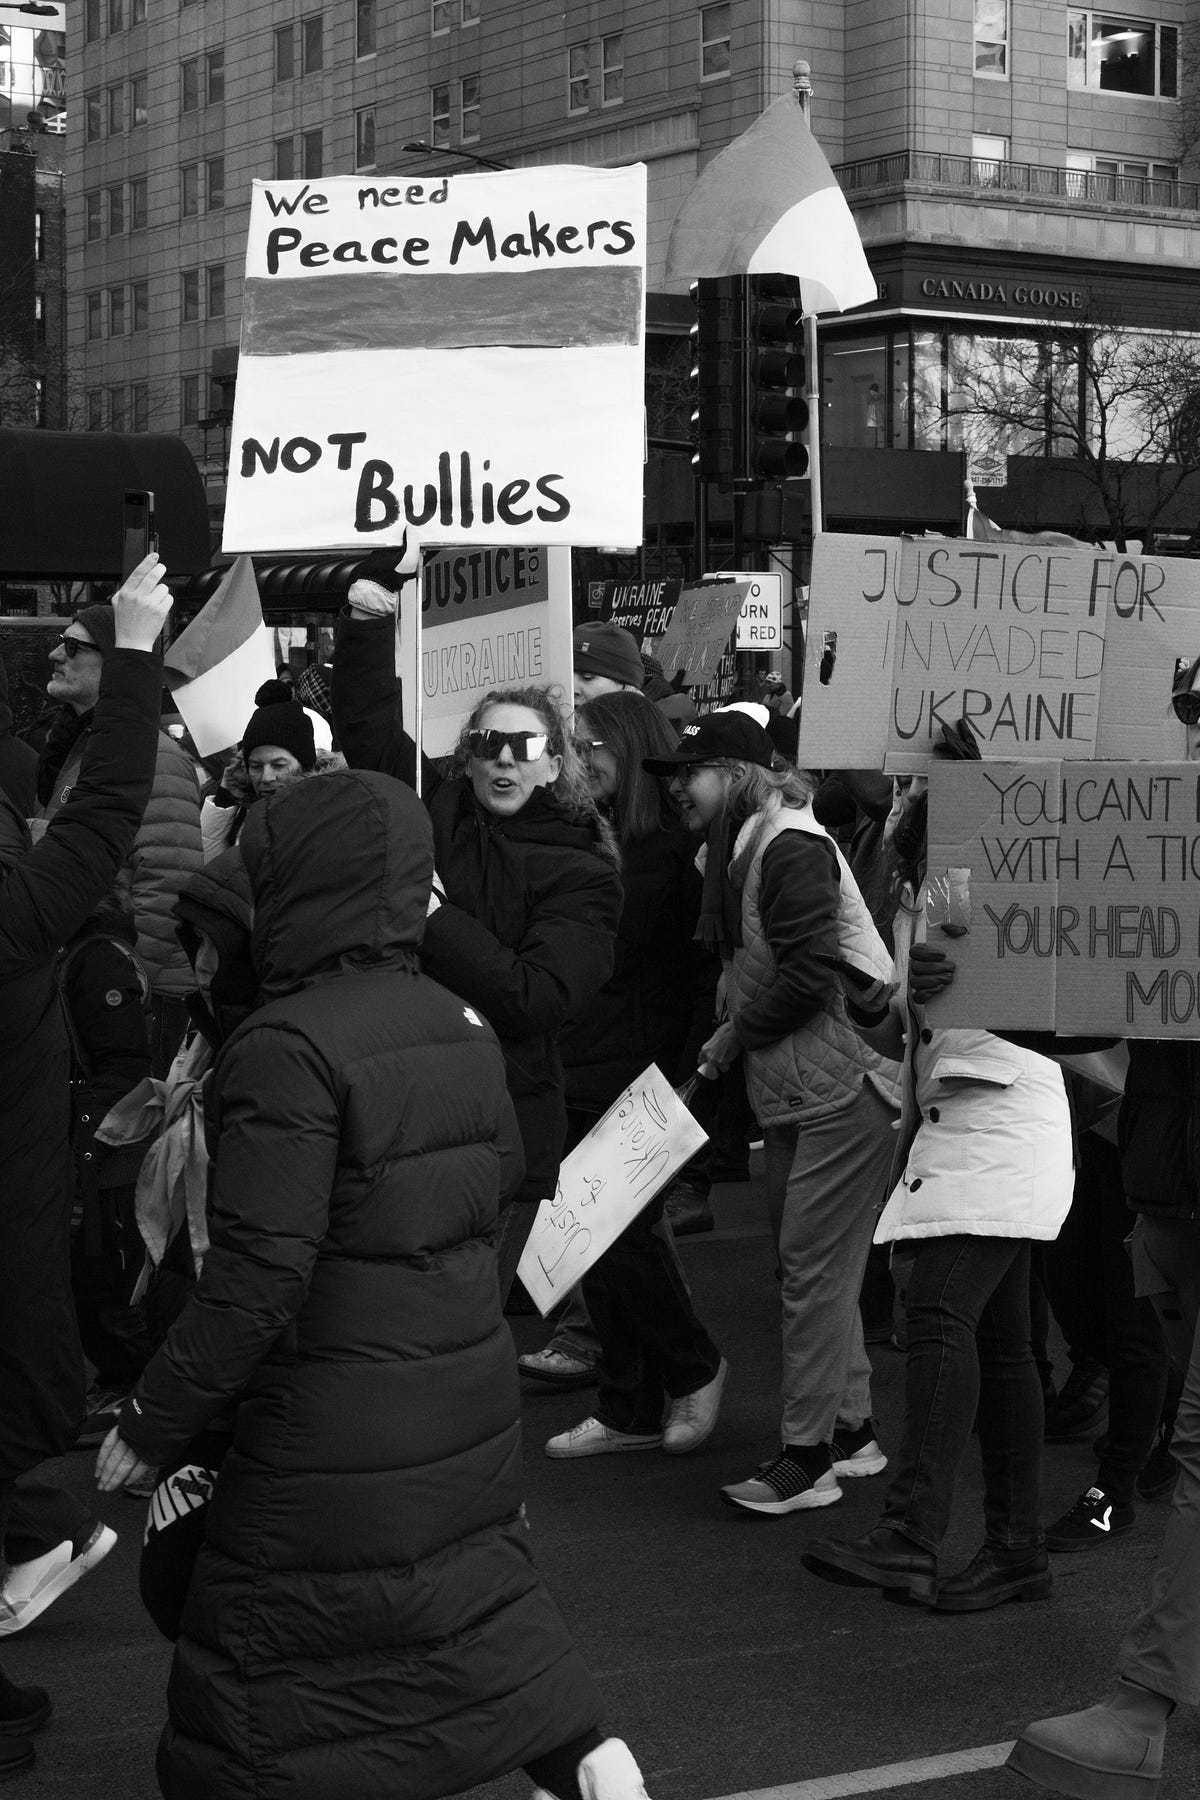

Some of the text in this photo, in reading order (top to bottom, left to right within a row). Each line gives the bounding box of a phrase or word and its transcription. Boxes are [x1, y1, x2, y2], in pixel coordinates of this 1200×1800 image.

[264, 179, 449, 217] We need
[266, 211, 636, 275] Peace Makers
[922, 278, 1084, 309] CANADA GOOSE
[240, 431, 367, 478] NOT
[354, 451, 571, 532] Bullies
[612, 581, 666, 609] UKRAINE
[750, 583, 761, 598] O
[862, 548, 1166, 622] JUSTICE FOR
[643, 605, 677, 634] PEAC
[739, 604, 769, 619] URN
[750, 626, 776, 640] RED
[422, 626, 543, 698] UKRAINE
[882, 619, 1107, 681] INVADED
[894, 688, 1097, 742] UKRAINE
[983, 772, 1067, 827] YOU
[1076, 775, 1183, 824] CAN'T
[981, 834, 1080, 881] WITH
[1102, 834, 1135, 881] A
[983, 903, 1081, 959] YOUR
[1089, 905, 1181, 959] HEAD
[580, 1173, 608, 1207] for
